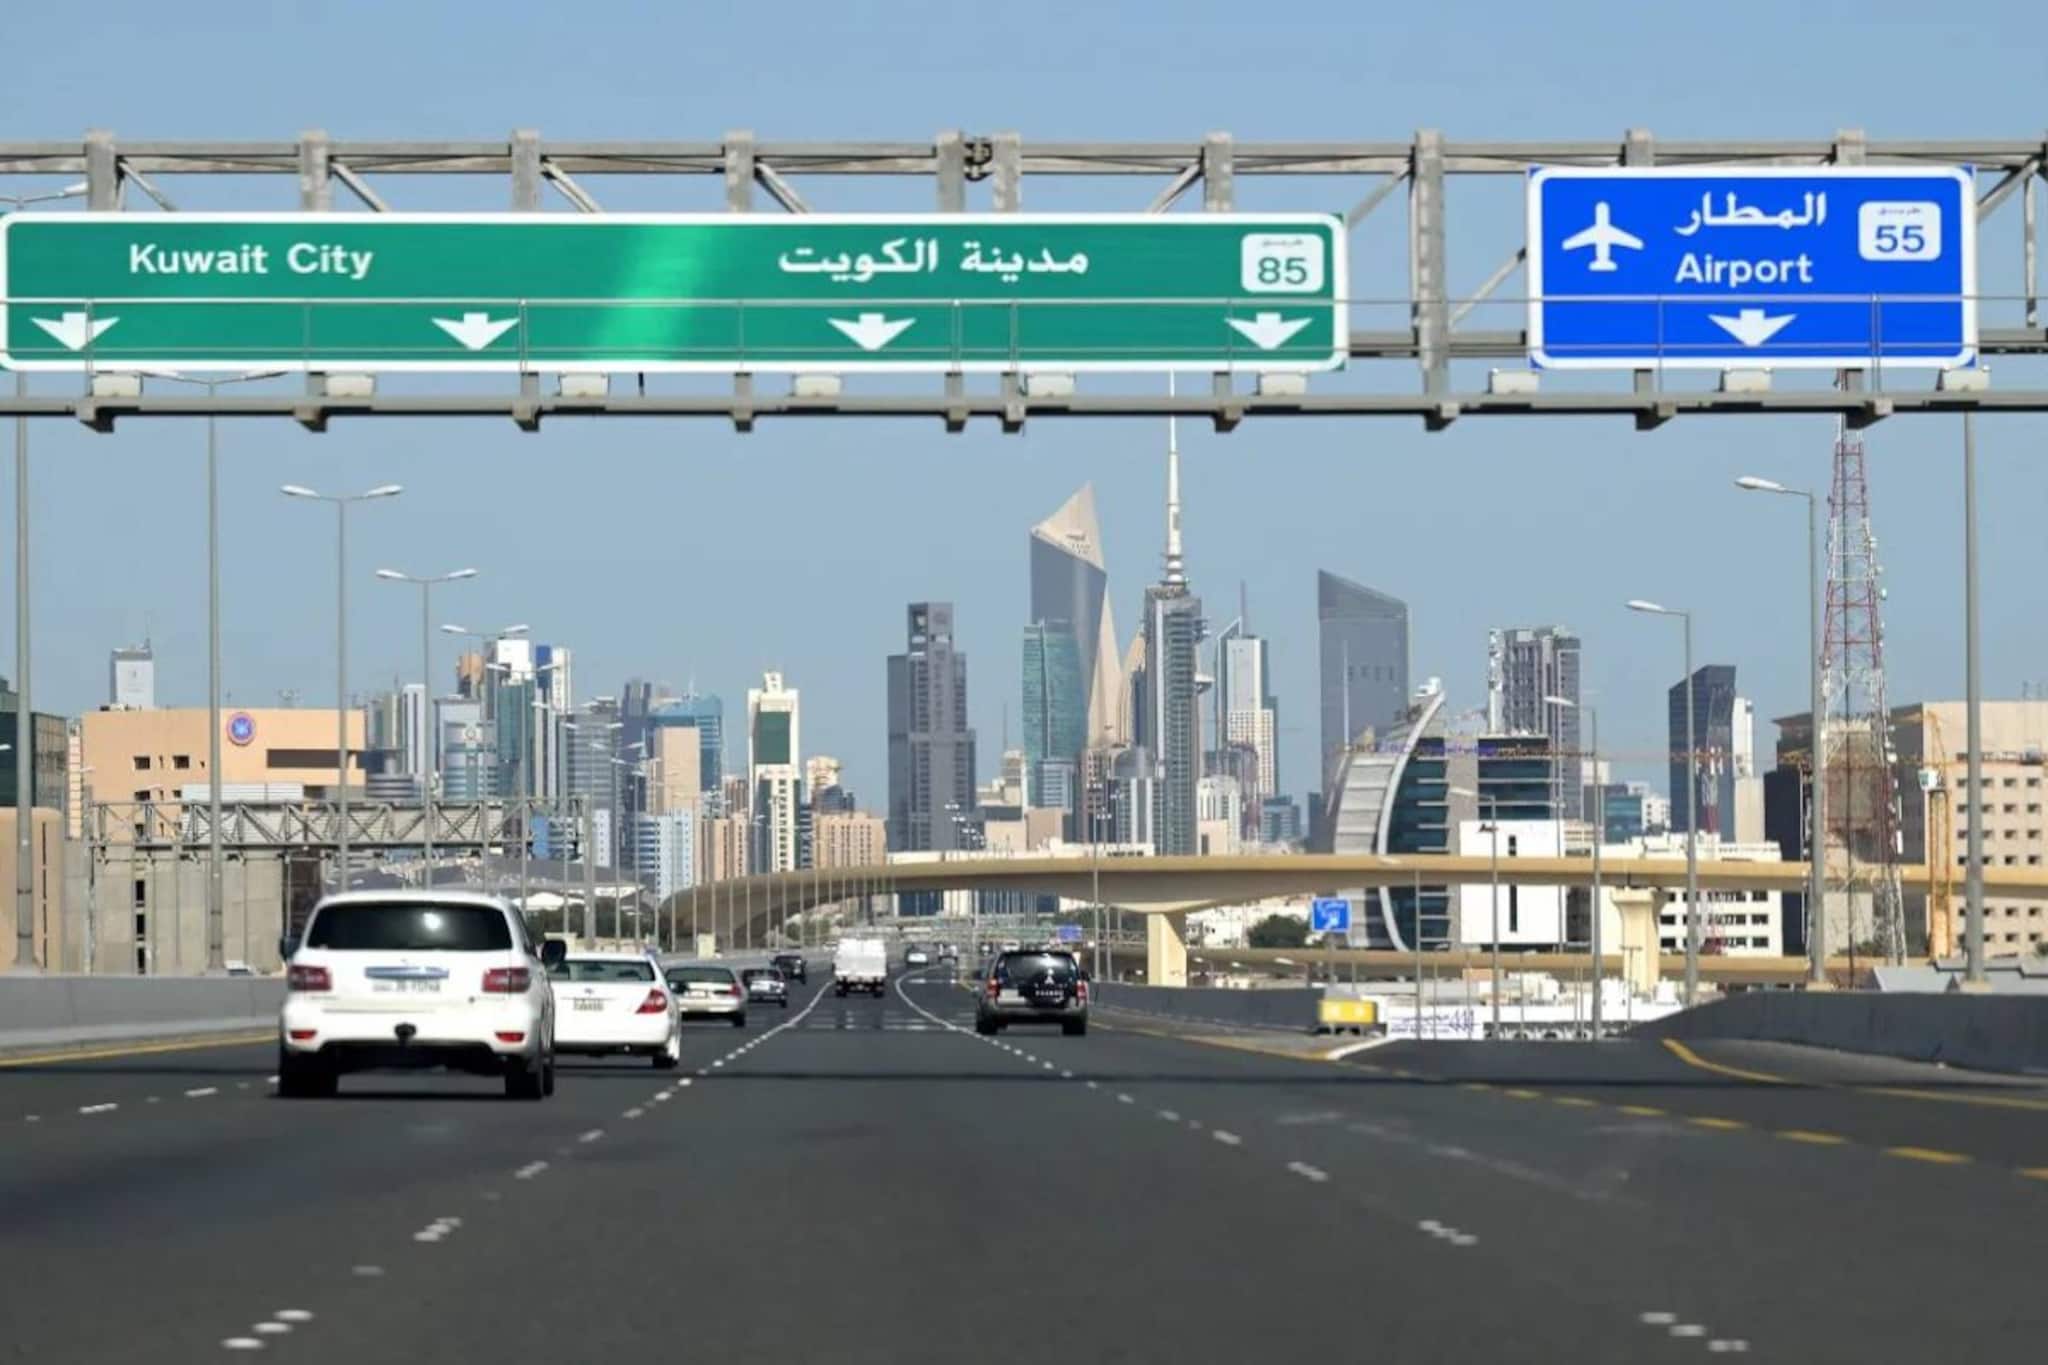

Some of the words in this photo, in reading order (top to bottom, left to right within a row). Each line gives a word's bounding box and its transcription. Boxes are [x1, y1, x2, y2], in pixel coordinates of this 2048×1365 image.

[1676, 192, 1827, 236] المطار
[1874, 223, 1927, 254] 55
[129, 243, 269, 275] Kuwait
[286, 242, 374, 280] City
[778, 238, 940, 283] الكويت
[960, 241, 1090, 283] مدينة
[1257, 255, 1309, 286] 85
[1675, 253, 1813, 288] Airport
